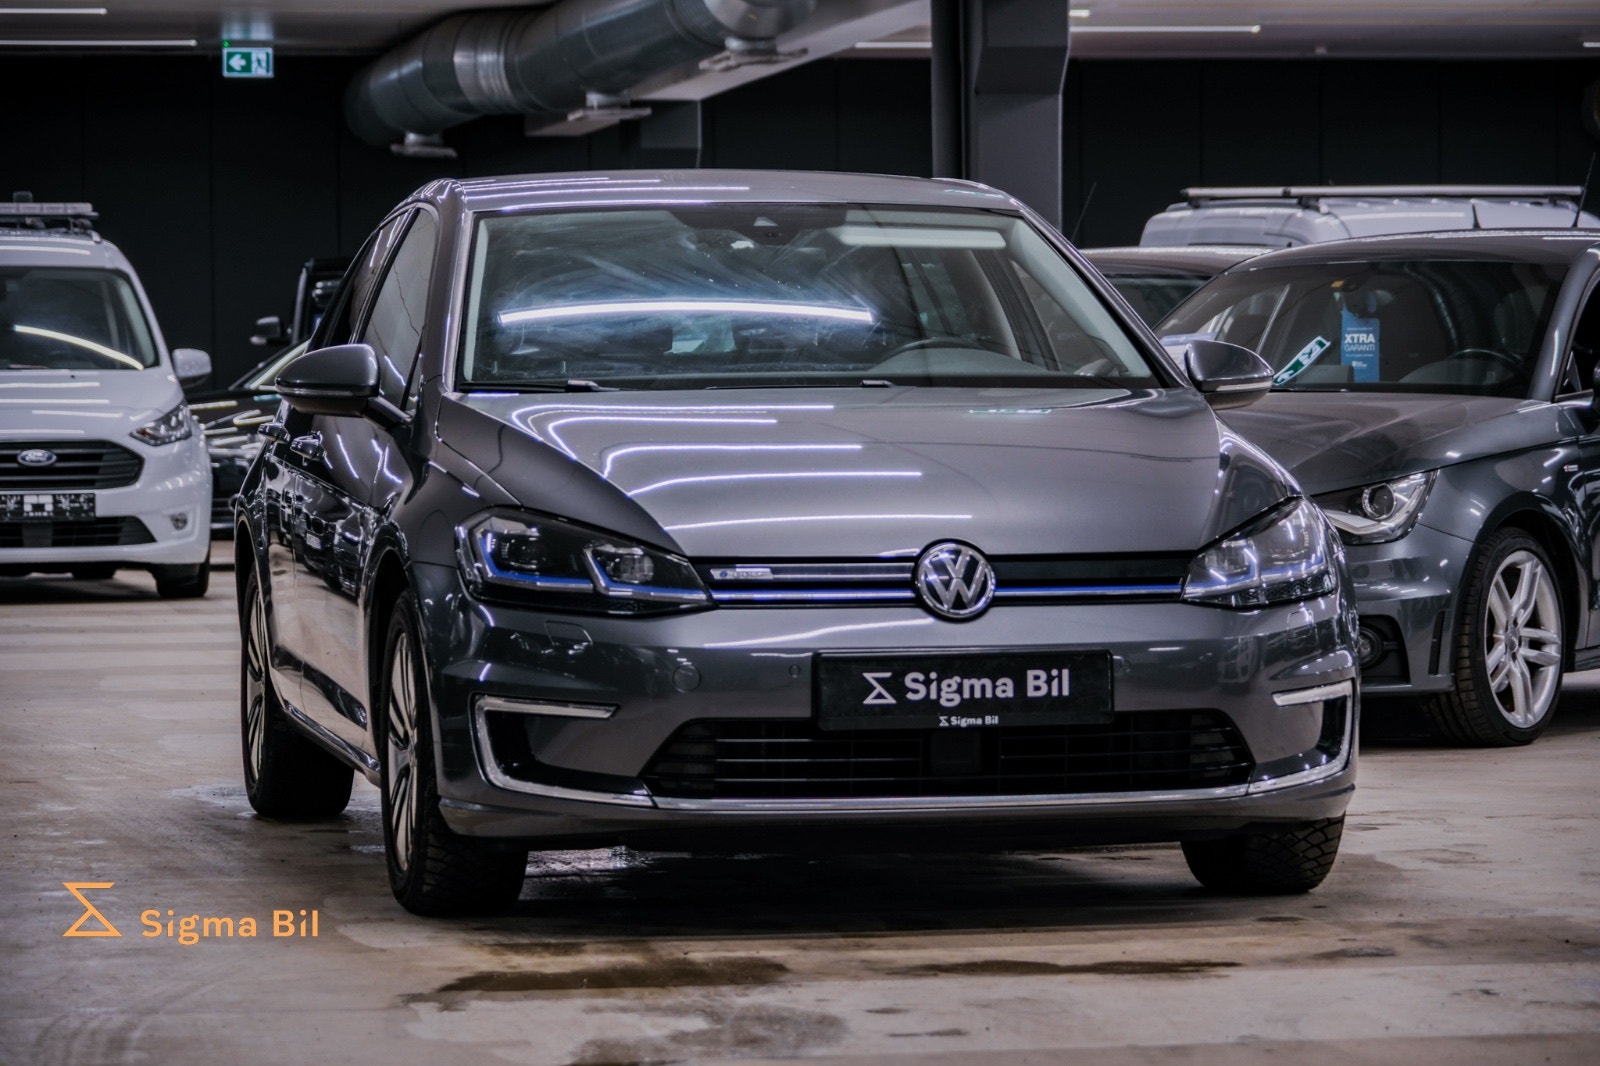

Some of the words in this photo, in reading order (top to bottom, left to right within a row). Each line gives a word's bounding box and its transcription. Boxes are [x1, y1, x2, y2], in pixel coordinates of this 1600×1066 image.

[1344, 333, 1376, 344] XTRA
[1344, 344, 1376, 352] GARANTI
[918, 543, 996, 618] VW
[904, 671, 1015, 707] Sigma
[1026, 668, 1070, 698] Bil
[950, 716, 983, 728] Sigma
[984, 715, 999, 725] Bil
